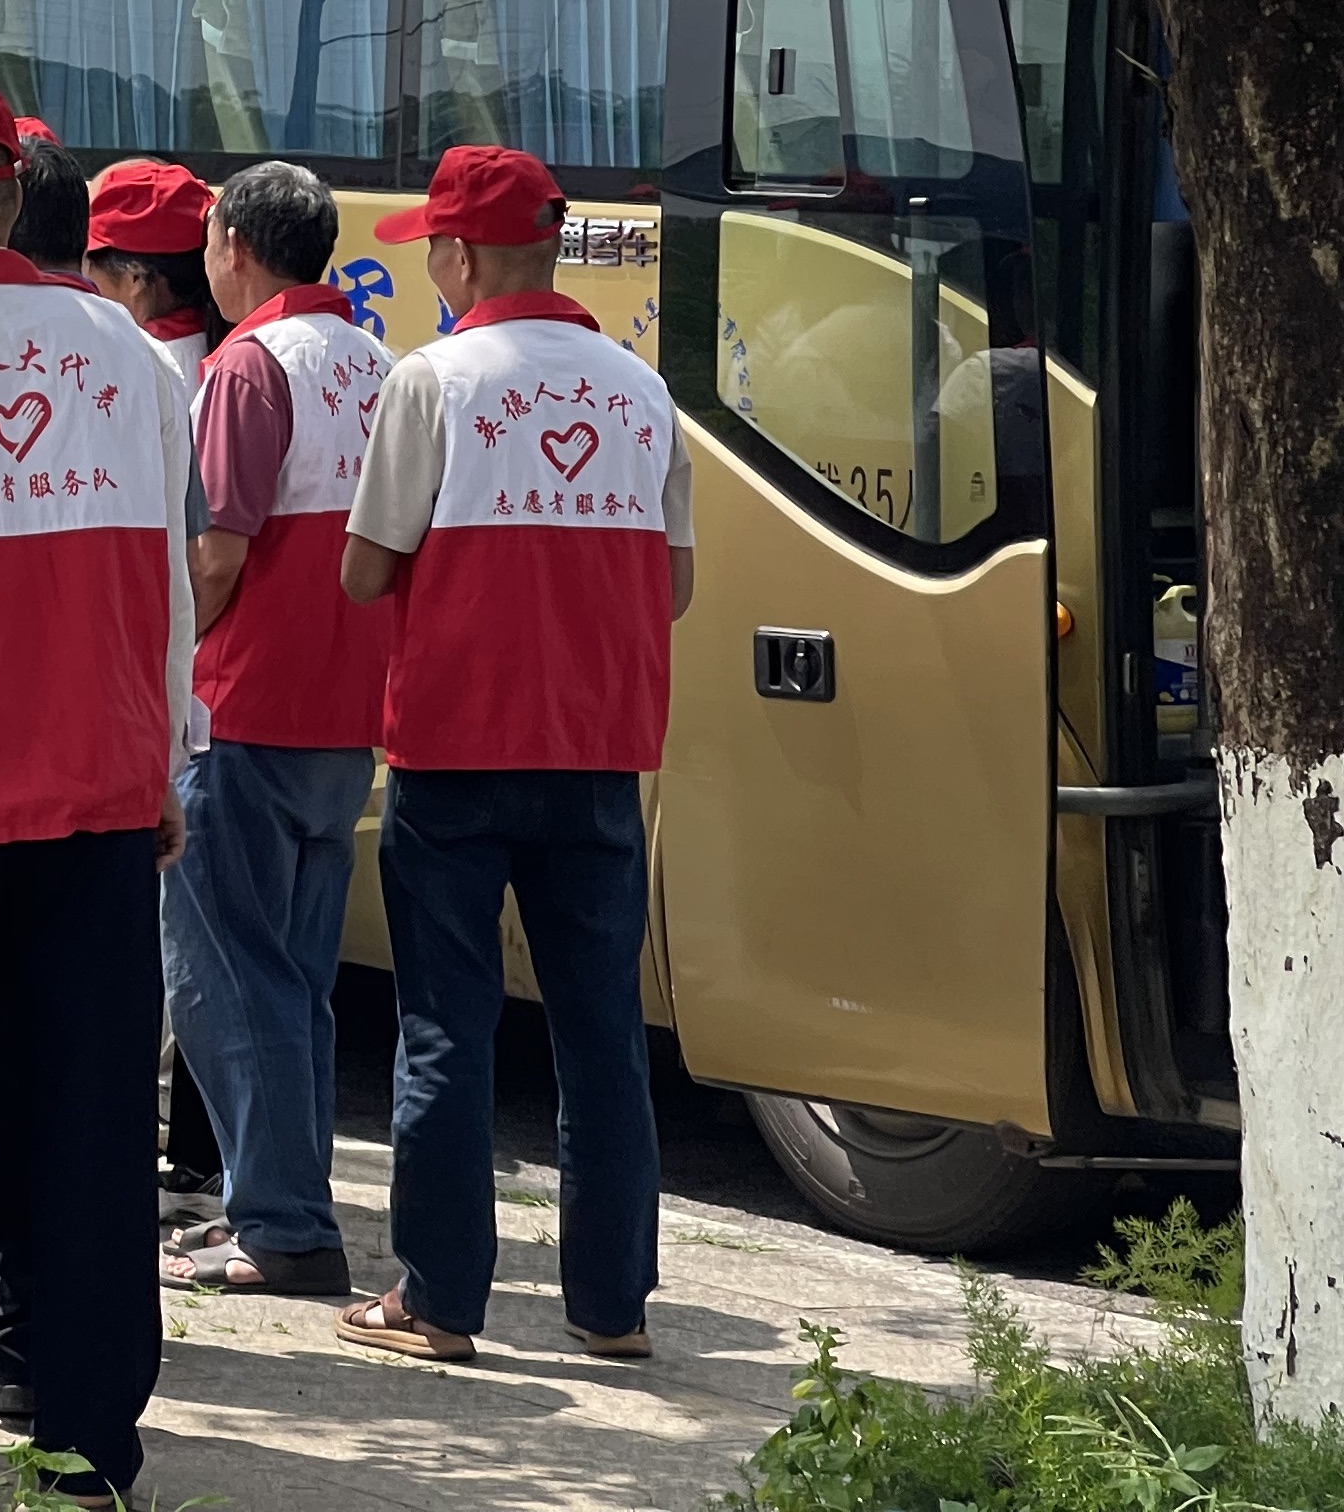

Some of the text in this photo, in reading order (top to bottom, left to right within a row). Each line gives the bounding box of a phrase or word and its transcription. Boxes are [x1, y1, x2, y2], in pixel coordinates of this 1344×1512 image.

[321, 351, 388, 417] 英德人大
[474, 377, 654, 451] 英德人大代表
[492, 490, 645, 516] 志愿者服务队
